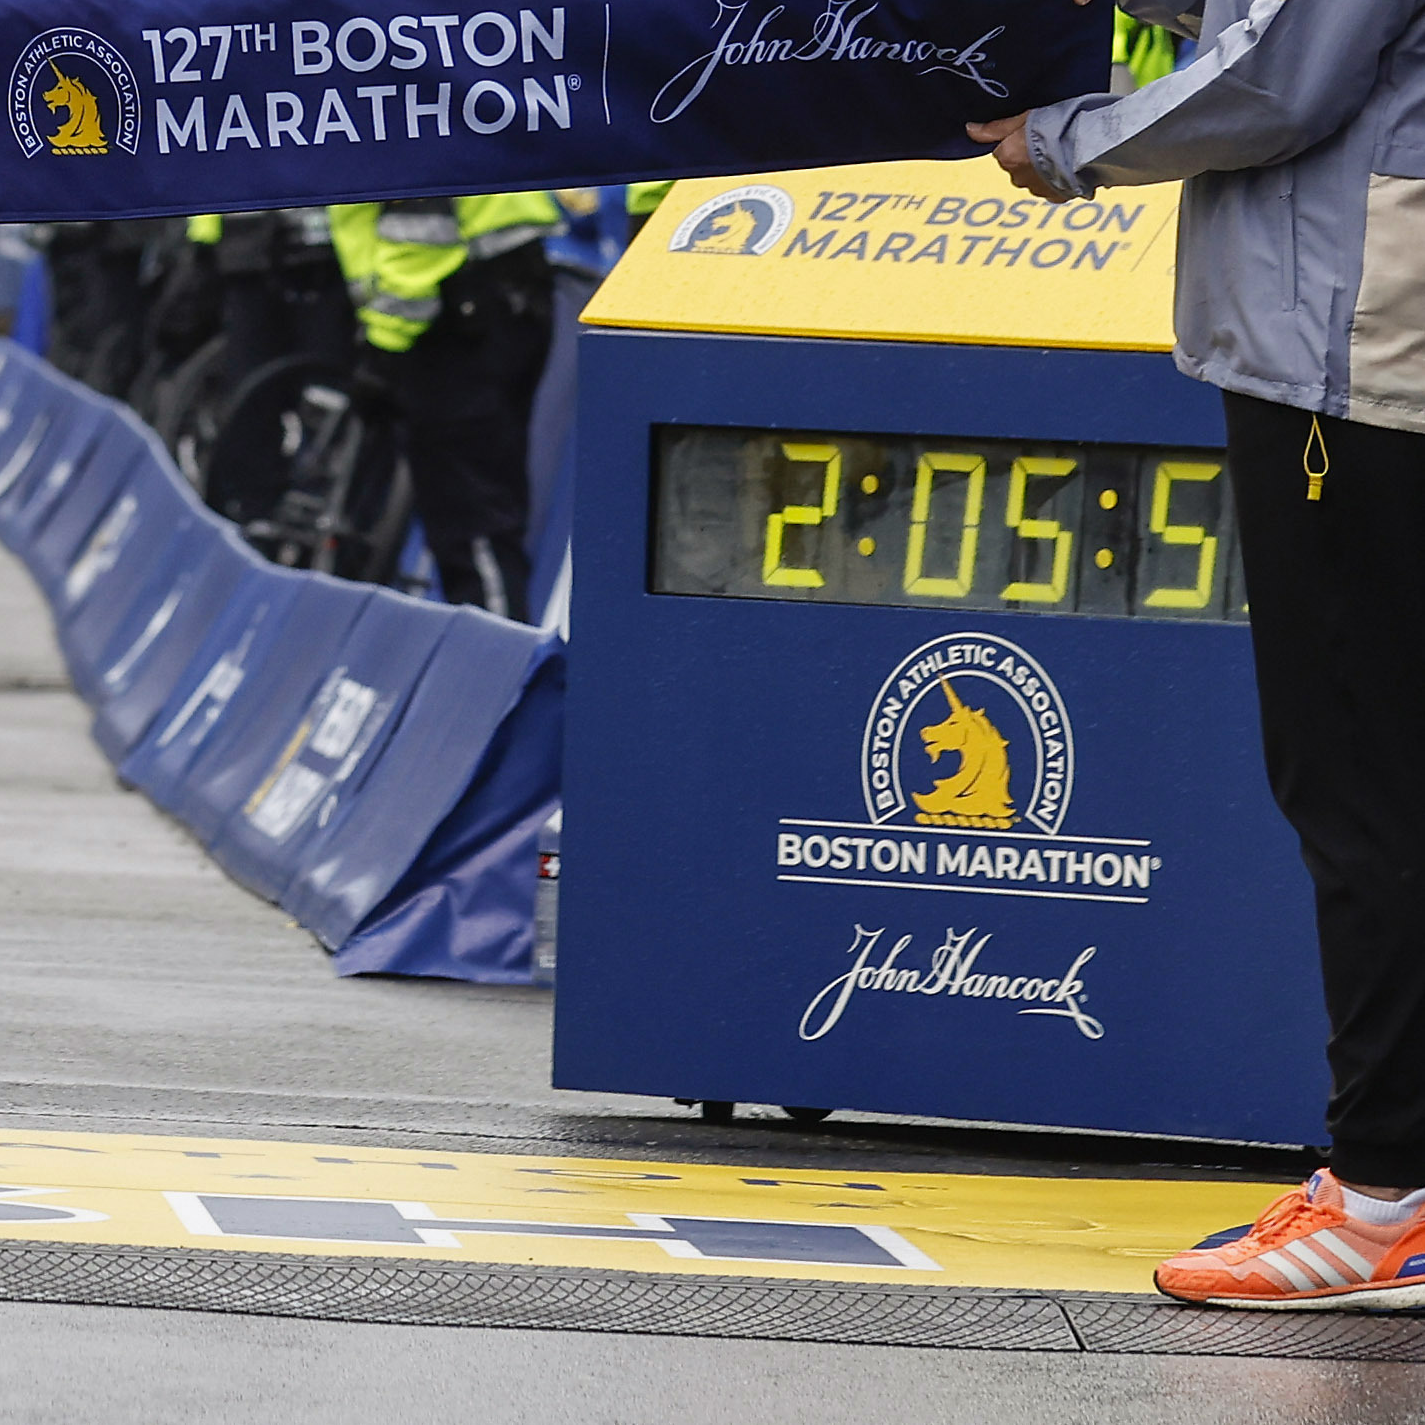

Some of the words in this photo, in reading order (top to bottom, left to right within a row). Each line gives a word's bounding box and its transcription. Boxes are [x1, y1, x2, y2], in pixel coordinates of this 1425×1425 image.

[24, 34, 83, 75] ATHLETIC
[142, 22, 277, 84] 127TH
[290, 7, 566, 76] BOSTON
[15, 74, 37, 148] BOSTON
[85, 40, 135, 146] ASSOCIATION
[155, 74, 574, 155] MARATHON
[782, 228, 1123, 273] MARATHON
[807, 191, 928, 223] 127TH
[925, 197, 1146, 235] BOSTON
[763, 442, 1224, 609] 2:05:5
[871, 696, 904, 811] BOSTON
[898, 643, 997, 700] ATHLETIC
[996, 656, 1064, 822] ASSOCIATION
[777, 833, 926, 875] BOSTON
[936, 845, 1150, 889] MARATHON
[799, 923, 923, 1042] John
[921, 926, 1105, 1040] Hancock
